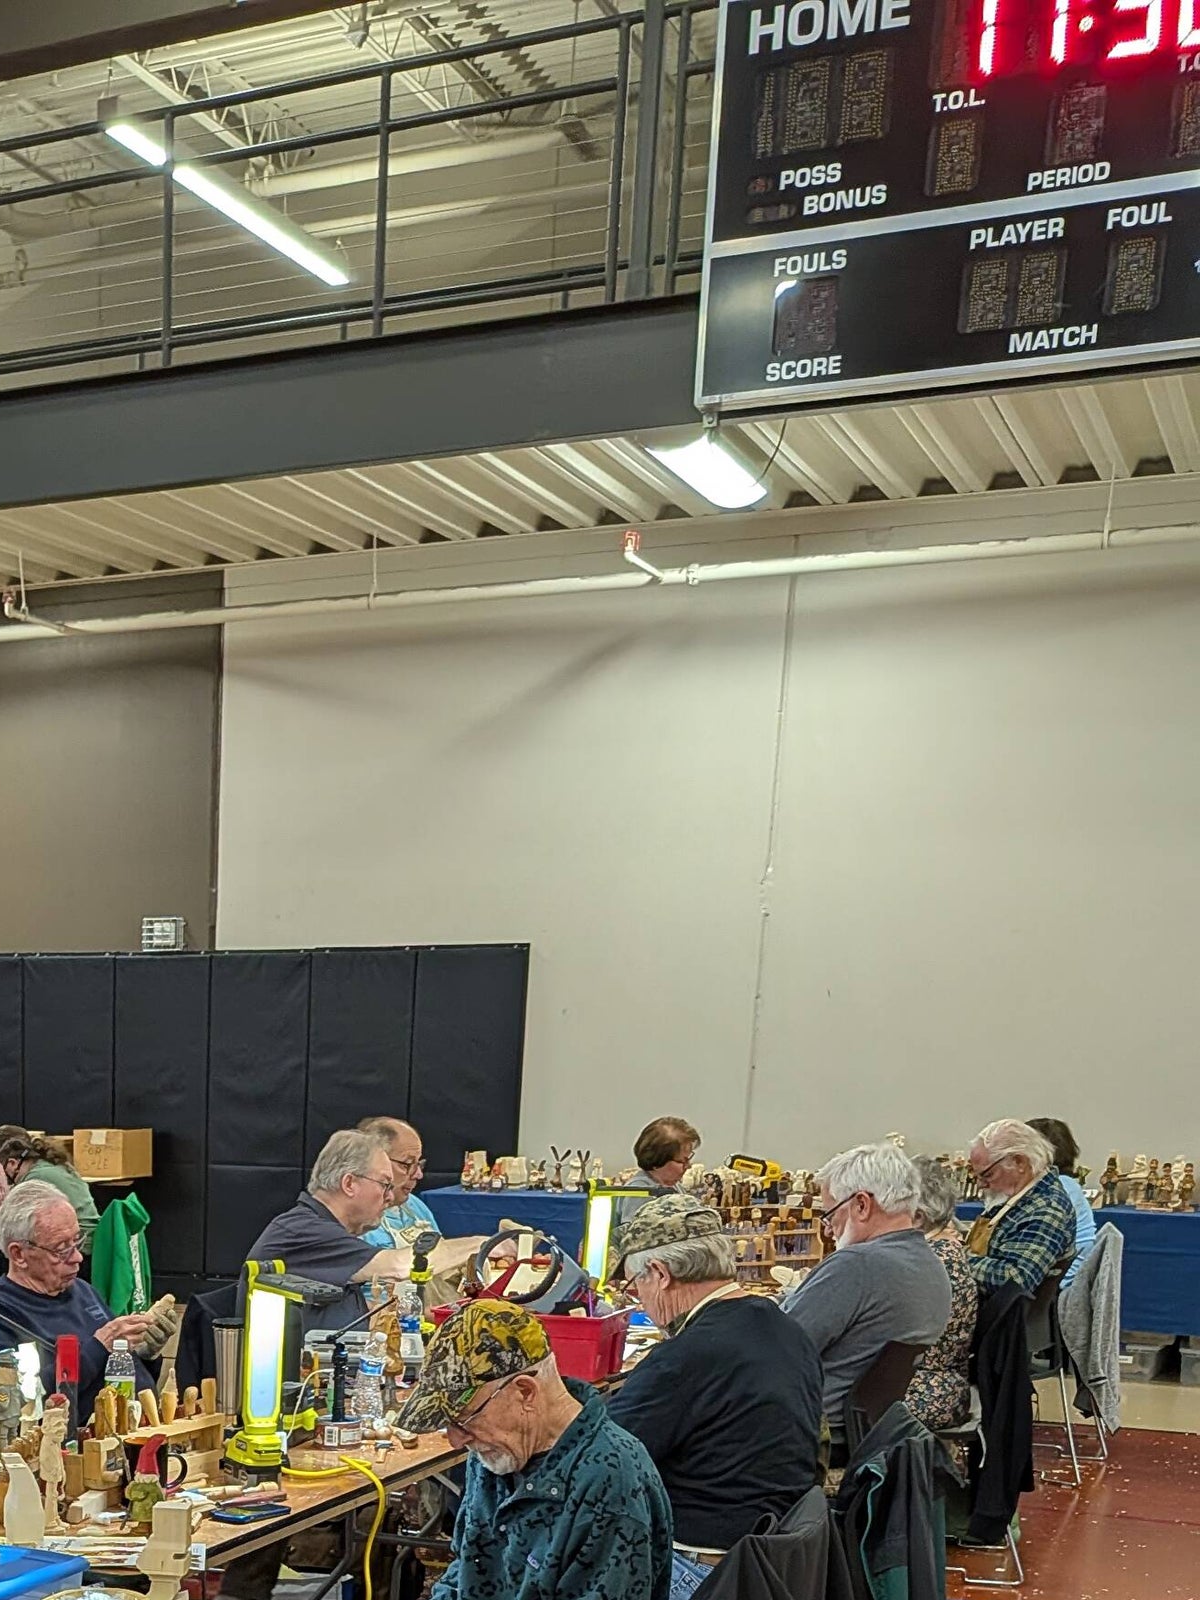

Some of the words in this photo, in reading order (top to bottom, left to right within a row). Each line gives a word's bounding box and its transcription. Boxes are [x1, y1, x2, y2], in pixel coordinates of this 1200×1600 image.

[748, 0, 910, 55] HOME
[932, 88, 986, 113] T.O.L.
[778, 162, 843, 191] POSS
[1026, 161, 1112, 192] PERIOD
[802, 183, 888, 216] BONUS
[1105, 201, 1173, 231] FOUL
[969, 217, 1066, 250] PLAYER
[773, 248, 848, 278] FOULS
[1007, 323, 1099, 354] MATCH
[765, 354, 843, 382] SCORE
